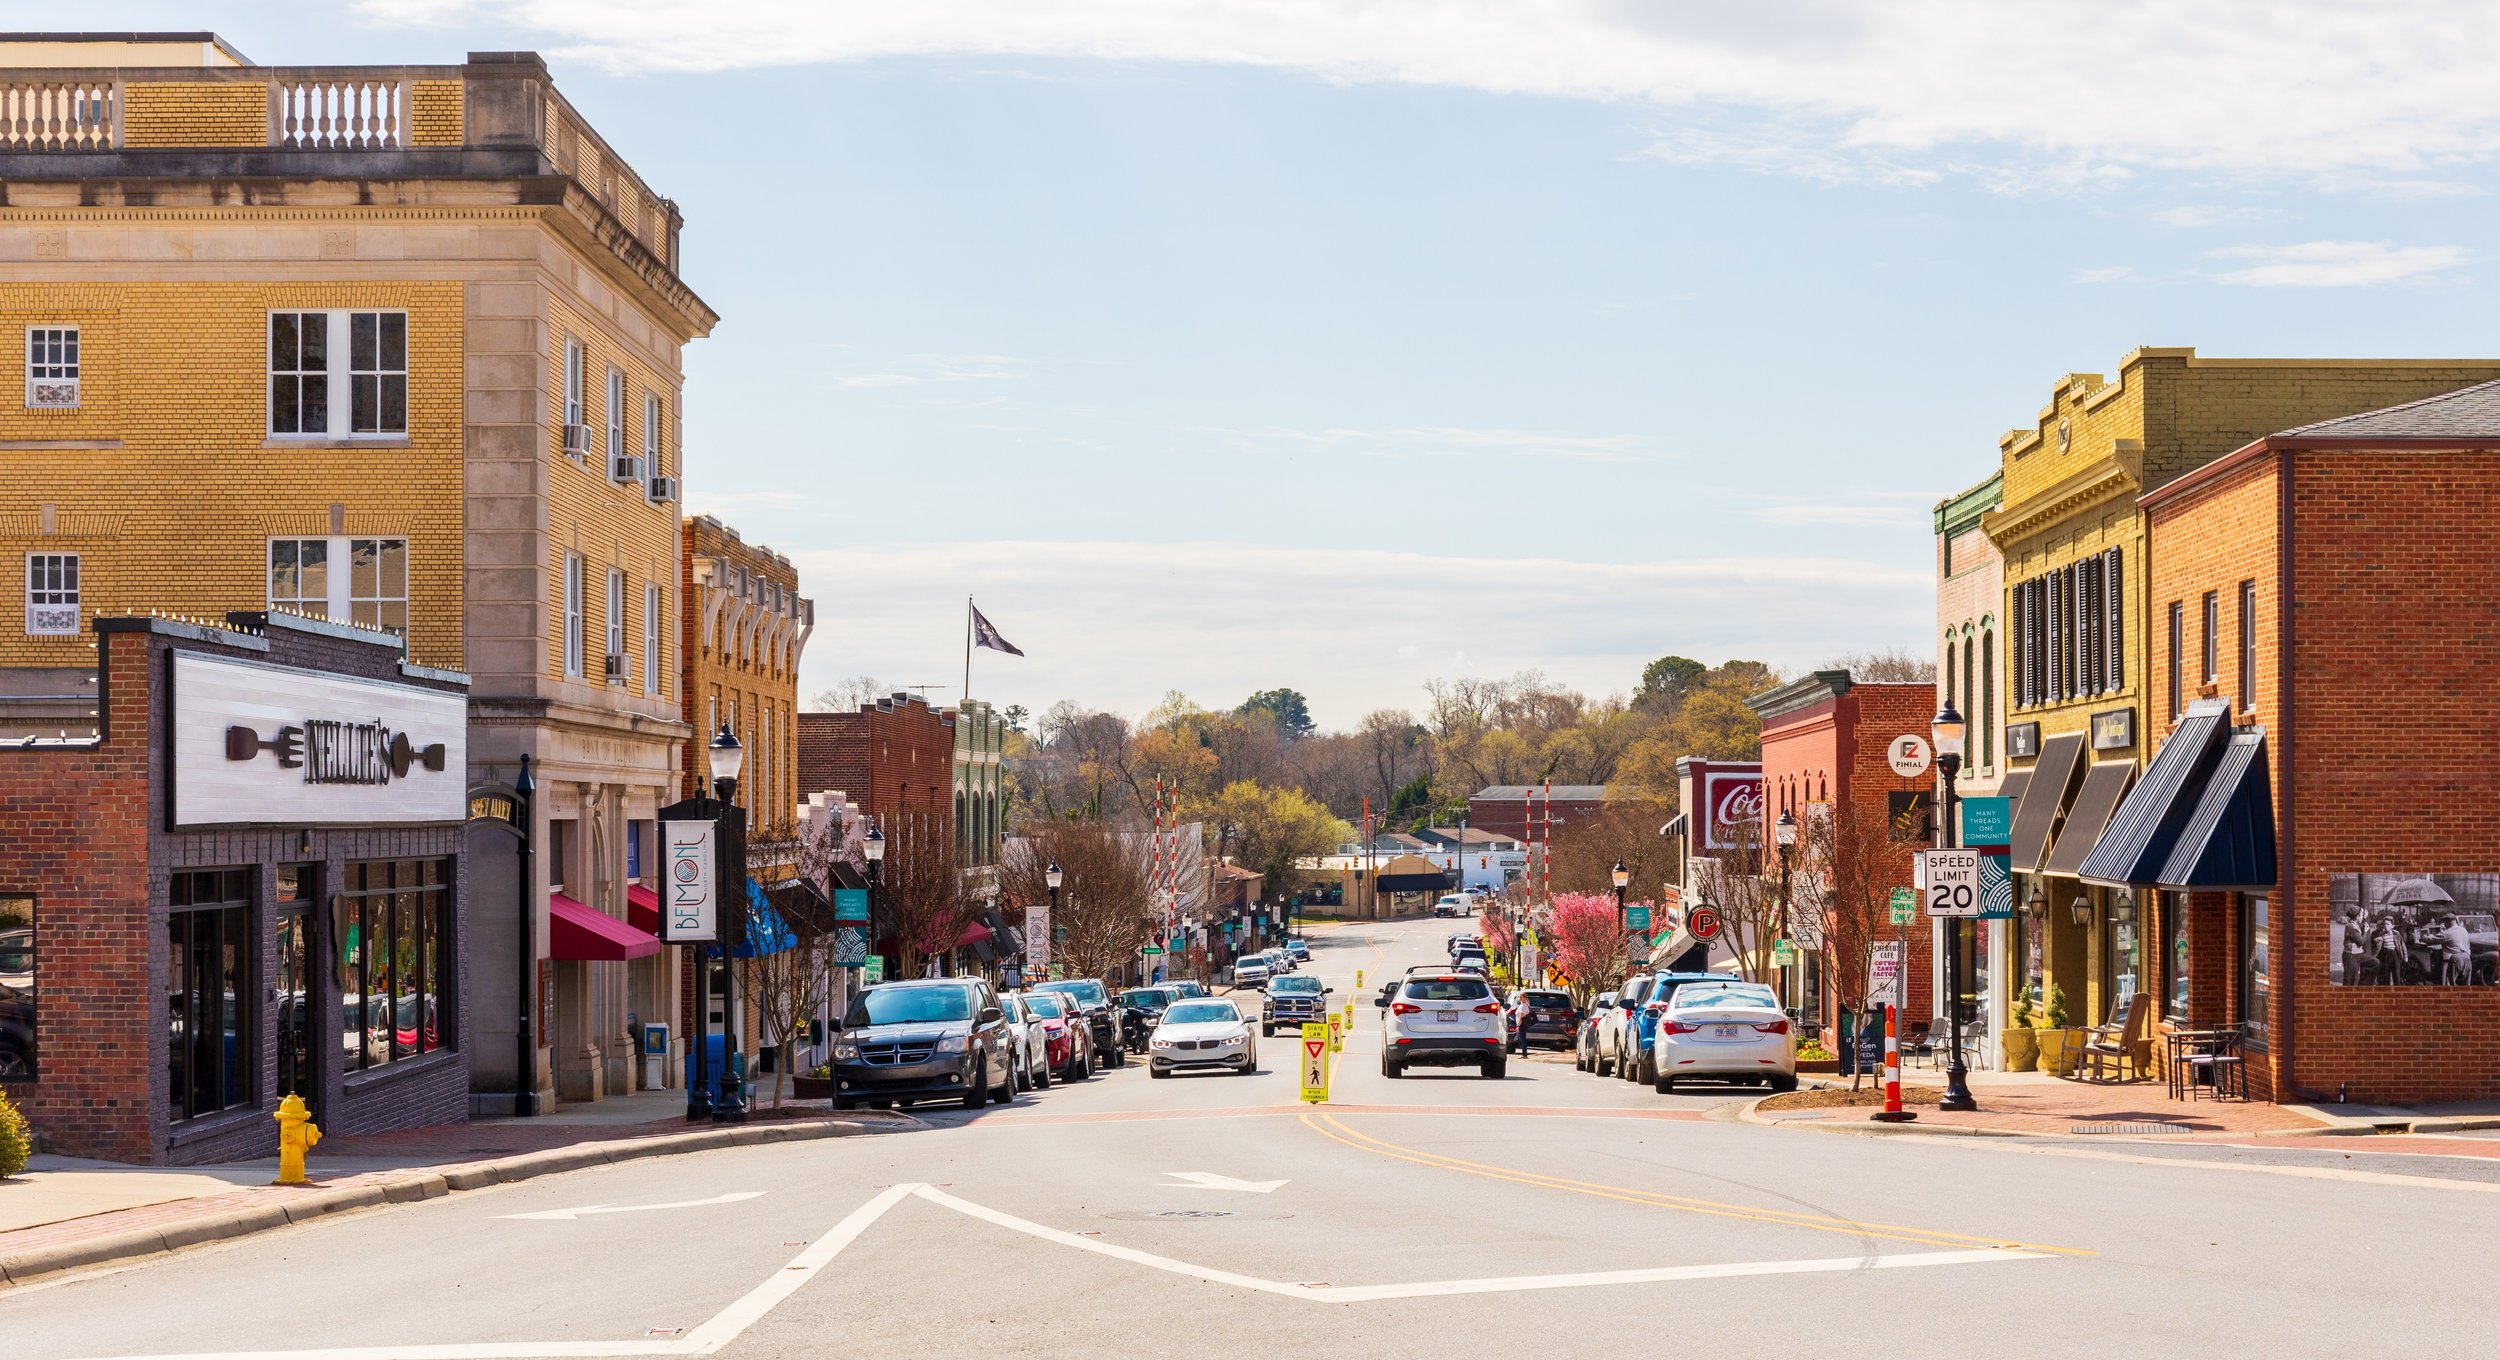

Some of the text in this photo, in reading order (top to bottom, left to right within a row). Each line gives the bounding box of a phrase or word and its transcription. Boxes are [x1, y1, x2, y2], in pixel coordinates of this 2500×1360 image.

[305, 716, 391, 786] NELLIE'S
[1930, 857, 1975, 868] SPEED
[1934, 871, 1970, 881] LIMIT
[1932, 884, 1973, 909] 20
[1698, 914, 1716, 933] P
[1894, 913, 1912, 921] ONLY
